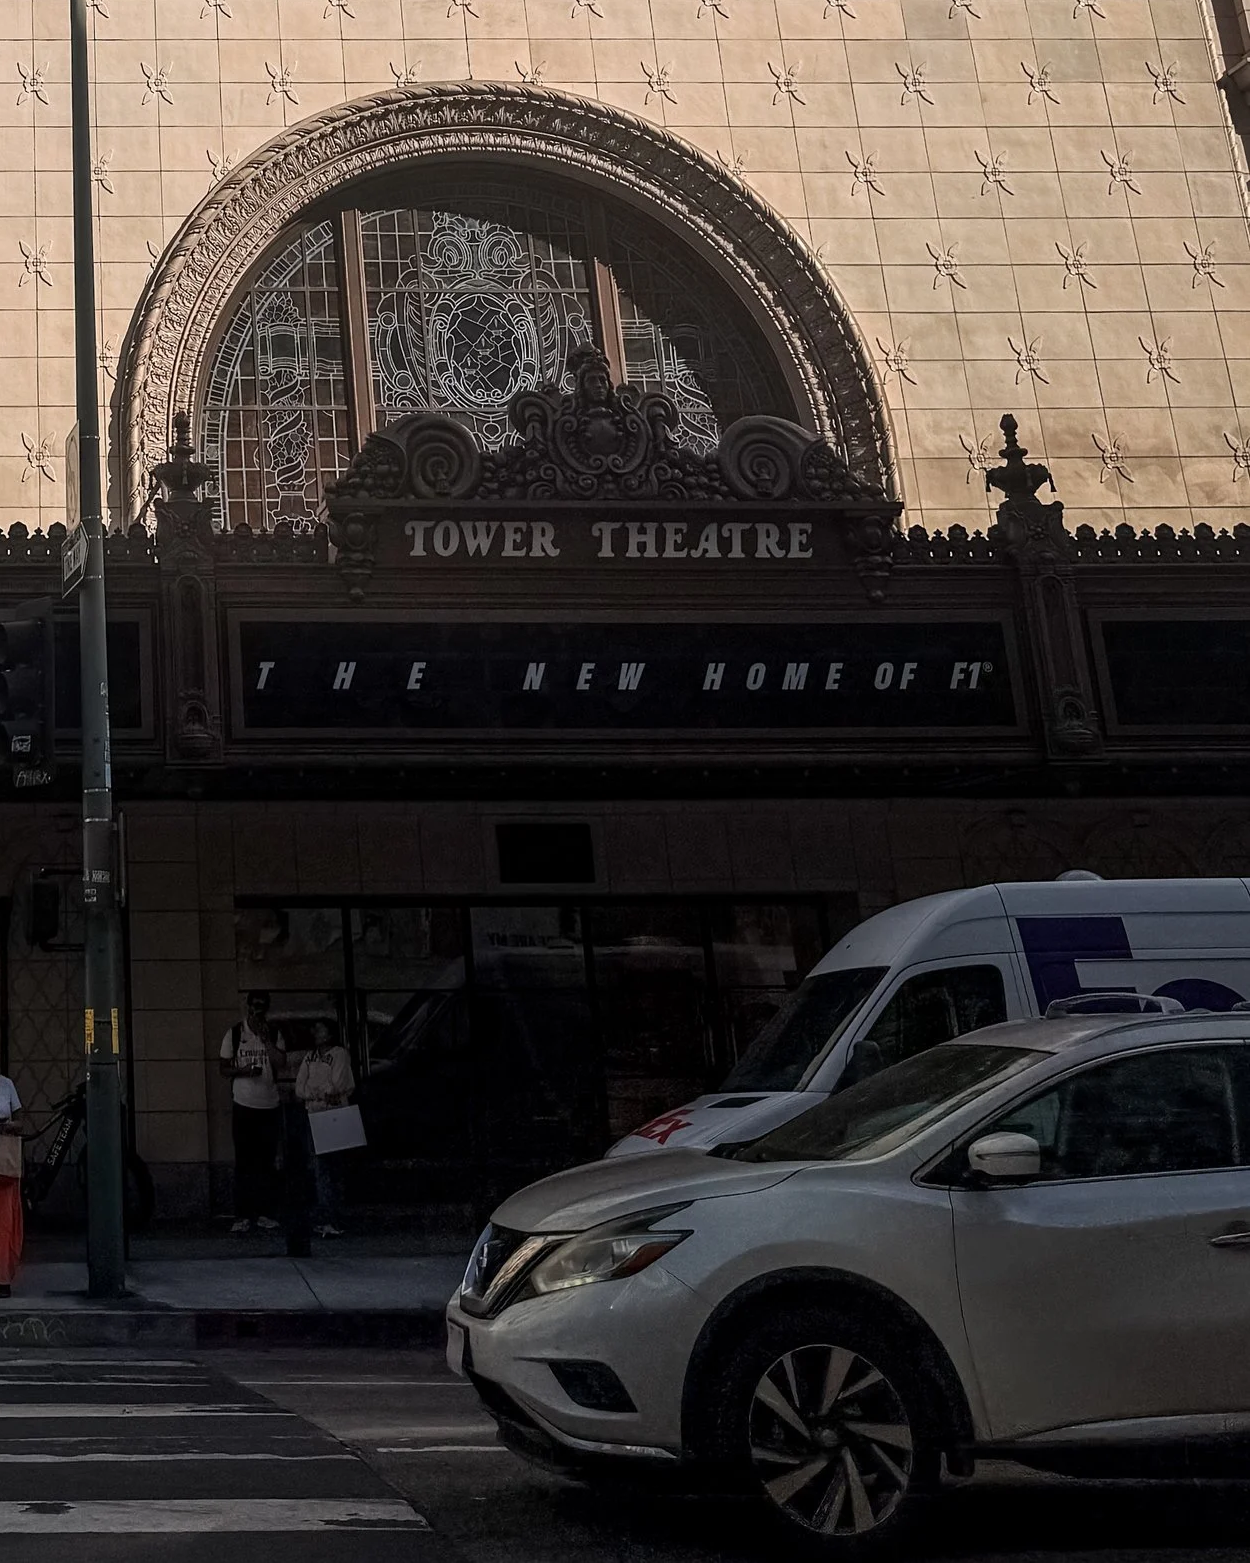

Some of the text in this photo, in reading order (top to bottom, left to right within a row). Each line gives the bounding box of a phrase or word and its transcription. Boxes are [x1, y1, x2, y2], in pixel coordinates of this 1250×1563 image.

[405, 520, 813, 559] TOWER THEATRE
[256, 661, 427, 691] THE
[522, 661, 647, 691] NEW
[703, 661, 843, 691] HOME
[874, 661, 919, 691] OF
